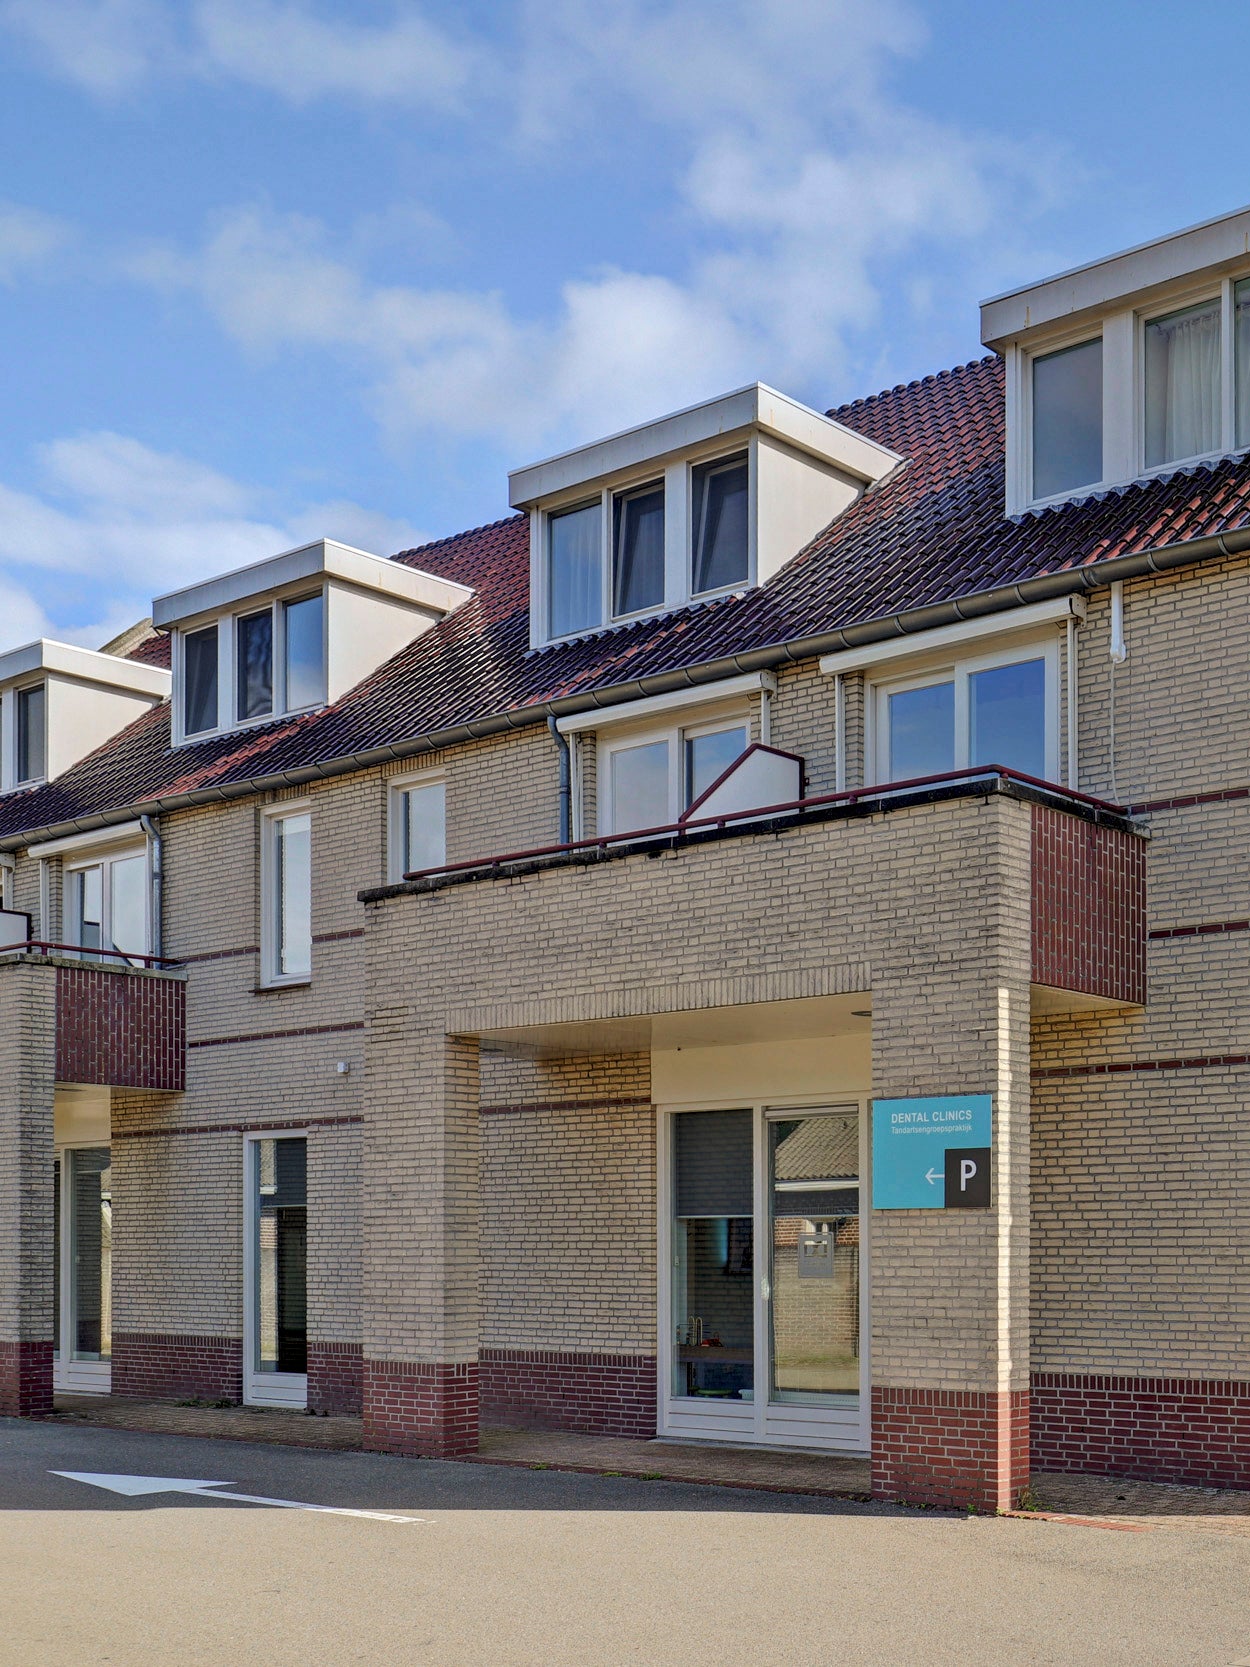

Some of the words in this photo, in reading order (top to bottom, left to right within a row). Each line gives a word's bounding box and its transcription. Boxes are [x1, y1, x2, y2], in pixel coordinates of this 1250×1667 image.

[891, 1112, 929, 1123] DENTAL
[932, 1110, 972, 1121] CLINICS
[891, 1125, 972, 1134] Tandartsengroepspraktijk
[960, 1159, 977, 1192] P
